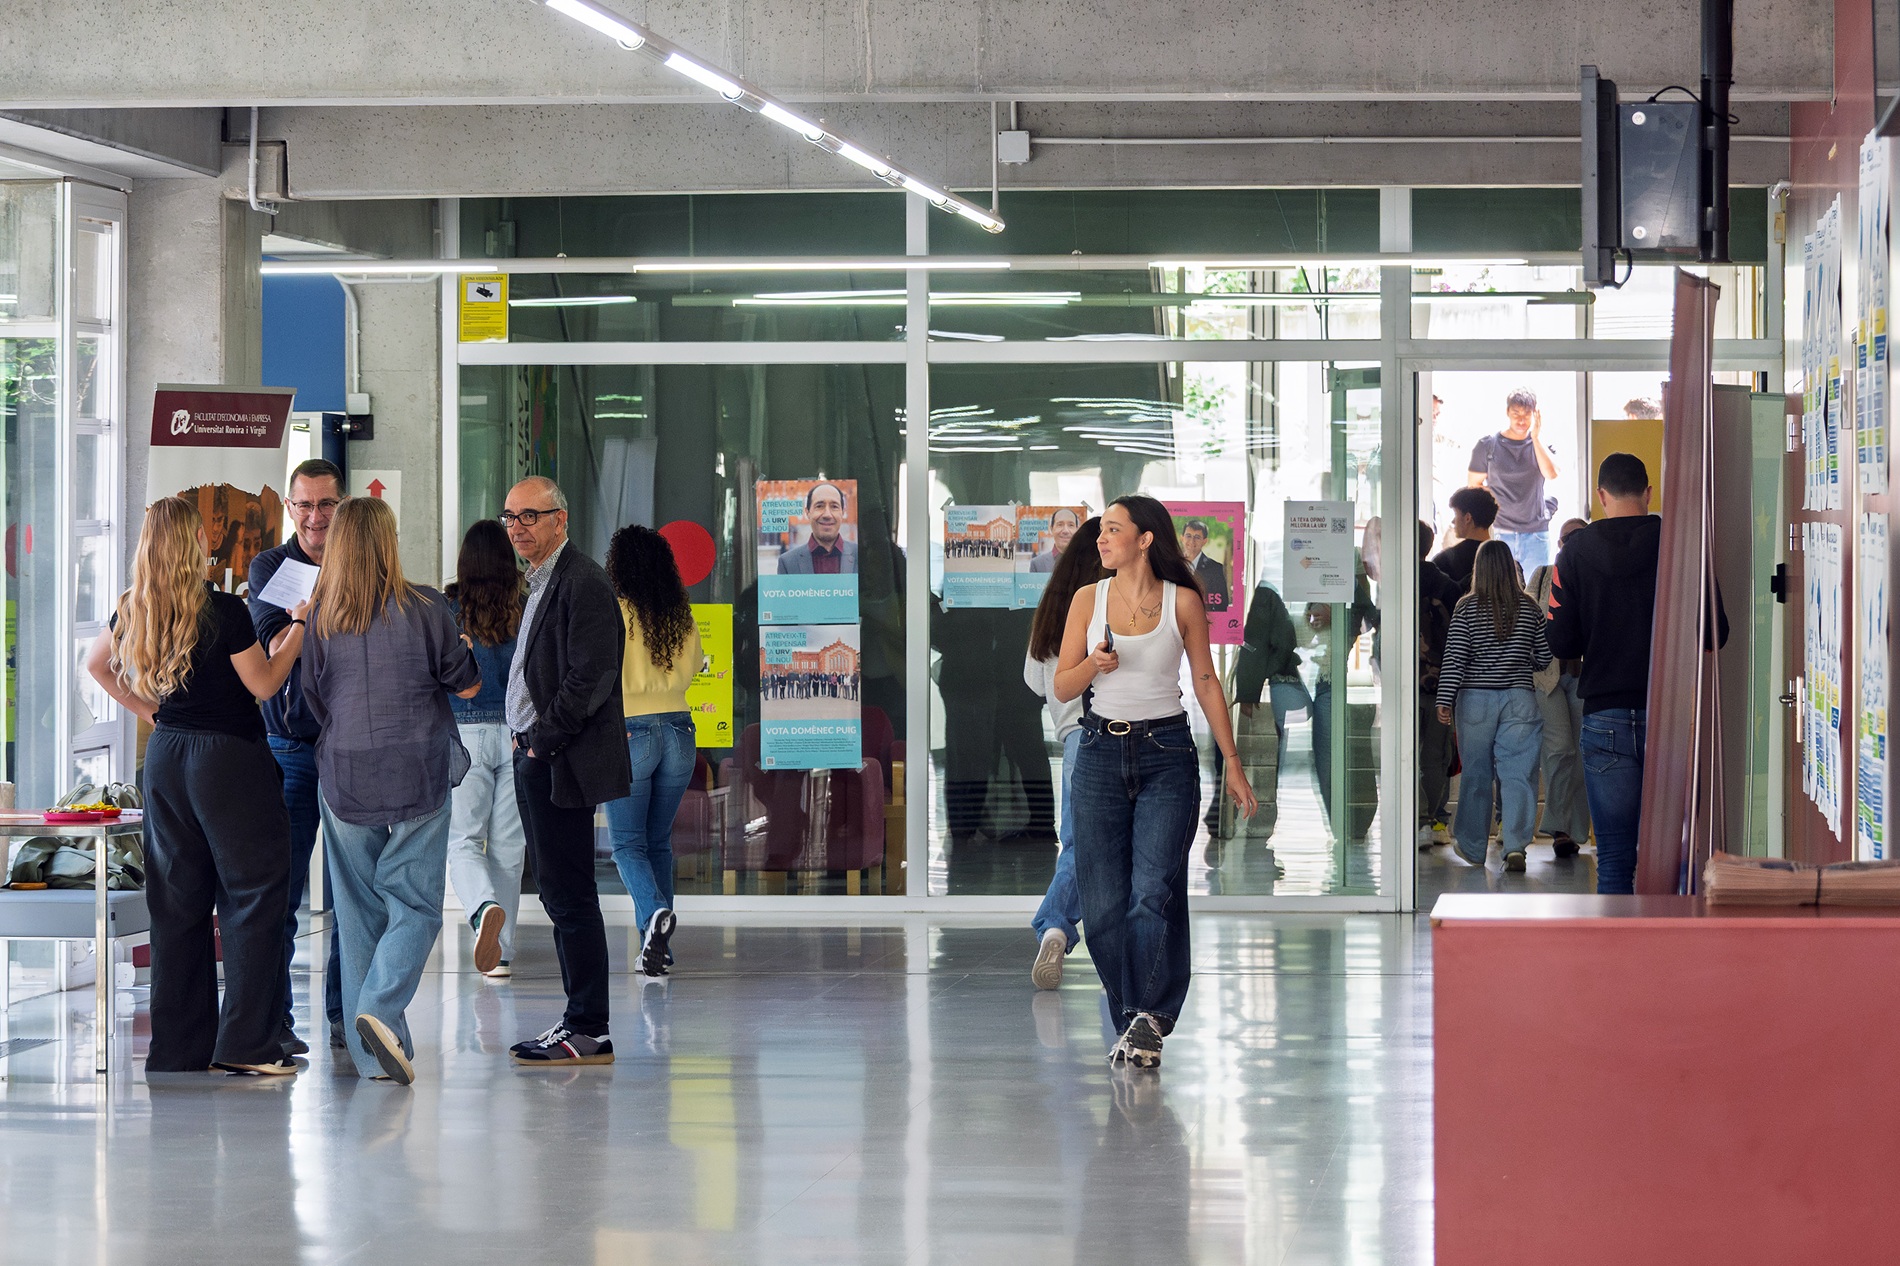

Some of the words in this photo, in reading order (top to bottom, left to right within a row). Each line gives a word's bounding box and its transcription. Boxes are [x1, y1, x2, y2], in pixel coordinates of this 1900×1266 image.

[194, 412, 217, 421] FACULTAT
[251, 414, 271, 422] EMPRESA
[194, 425, 224, 434] Universitat
[225, 425, 244, 434] Rovira
[246, 426, 249, 434] i
[250, 426, 267, 437] Virgili
[762, 500, 803, 508] ATREVEIX-TE
[763, 590, 786, 598] VOTA
[788, 588, 831, 597] DOMÈNEC
[833, 589, 854, 597] PUIG
[766, 727, 788, 735] VOTA
[791, 725, 834, 735] DOMÈNEC
[836, 726, 857, 734] PUIG
